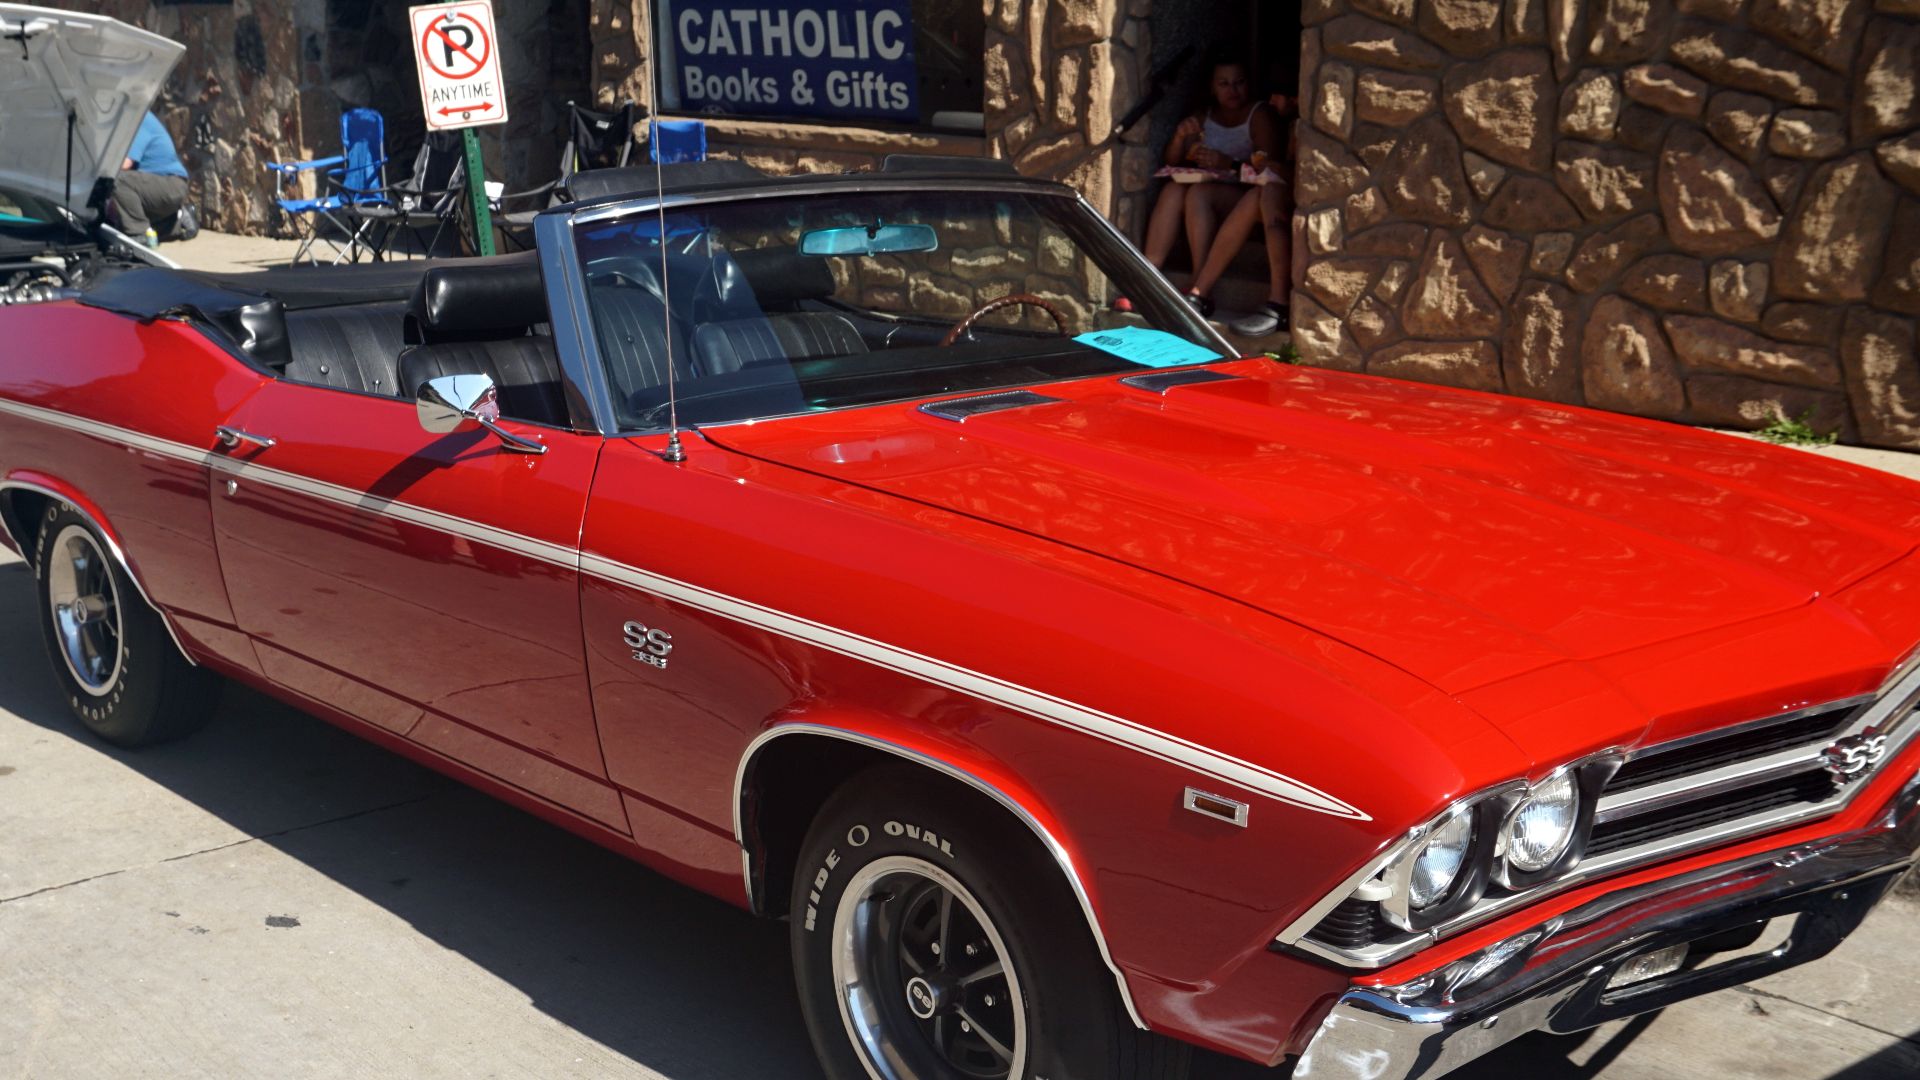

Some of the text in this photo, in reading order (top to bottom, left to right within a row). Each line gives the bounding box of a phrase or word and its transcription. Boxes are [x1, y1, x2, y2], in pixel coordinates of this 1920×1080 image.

[679, 8, 905, 60] CATHOLIC
[432, 81, 494, 103] ANYTIME
[684, 65, 910, 110] Books & Gifts
[623, 620, 672, 655] SS
[1840, 735, 1887, 774] SS
[804, 848, 841, 932] WIDE
[883, 820, 955, 859] OVAL
